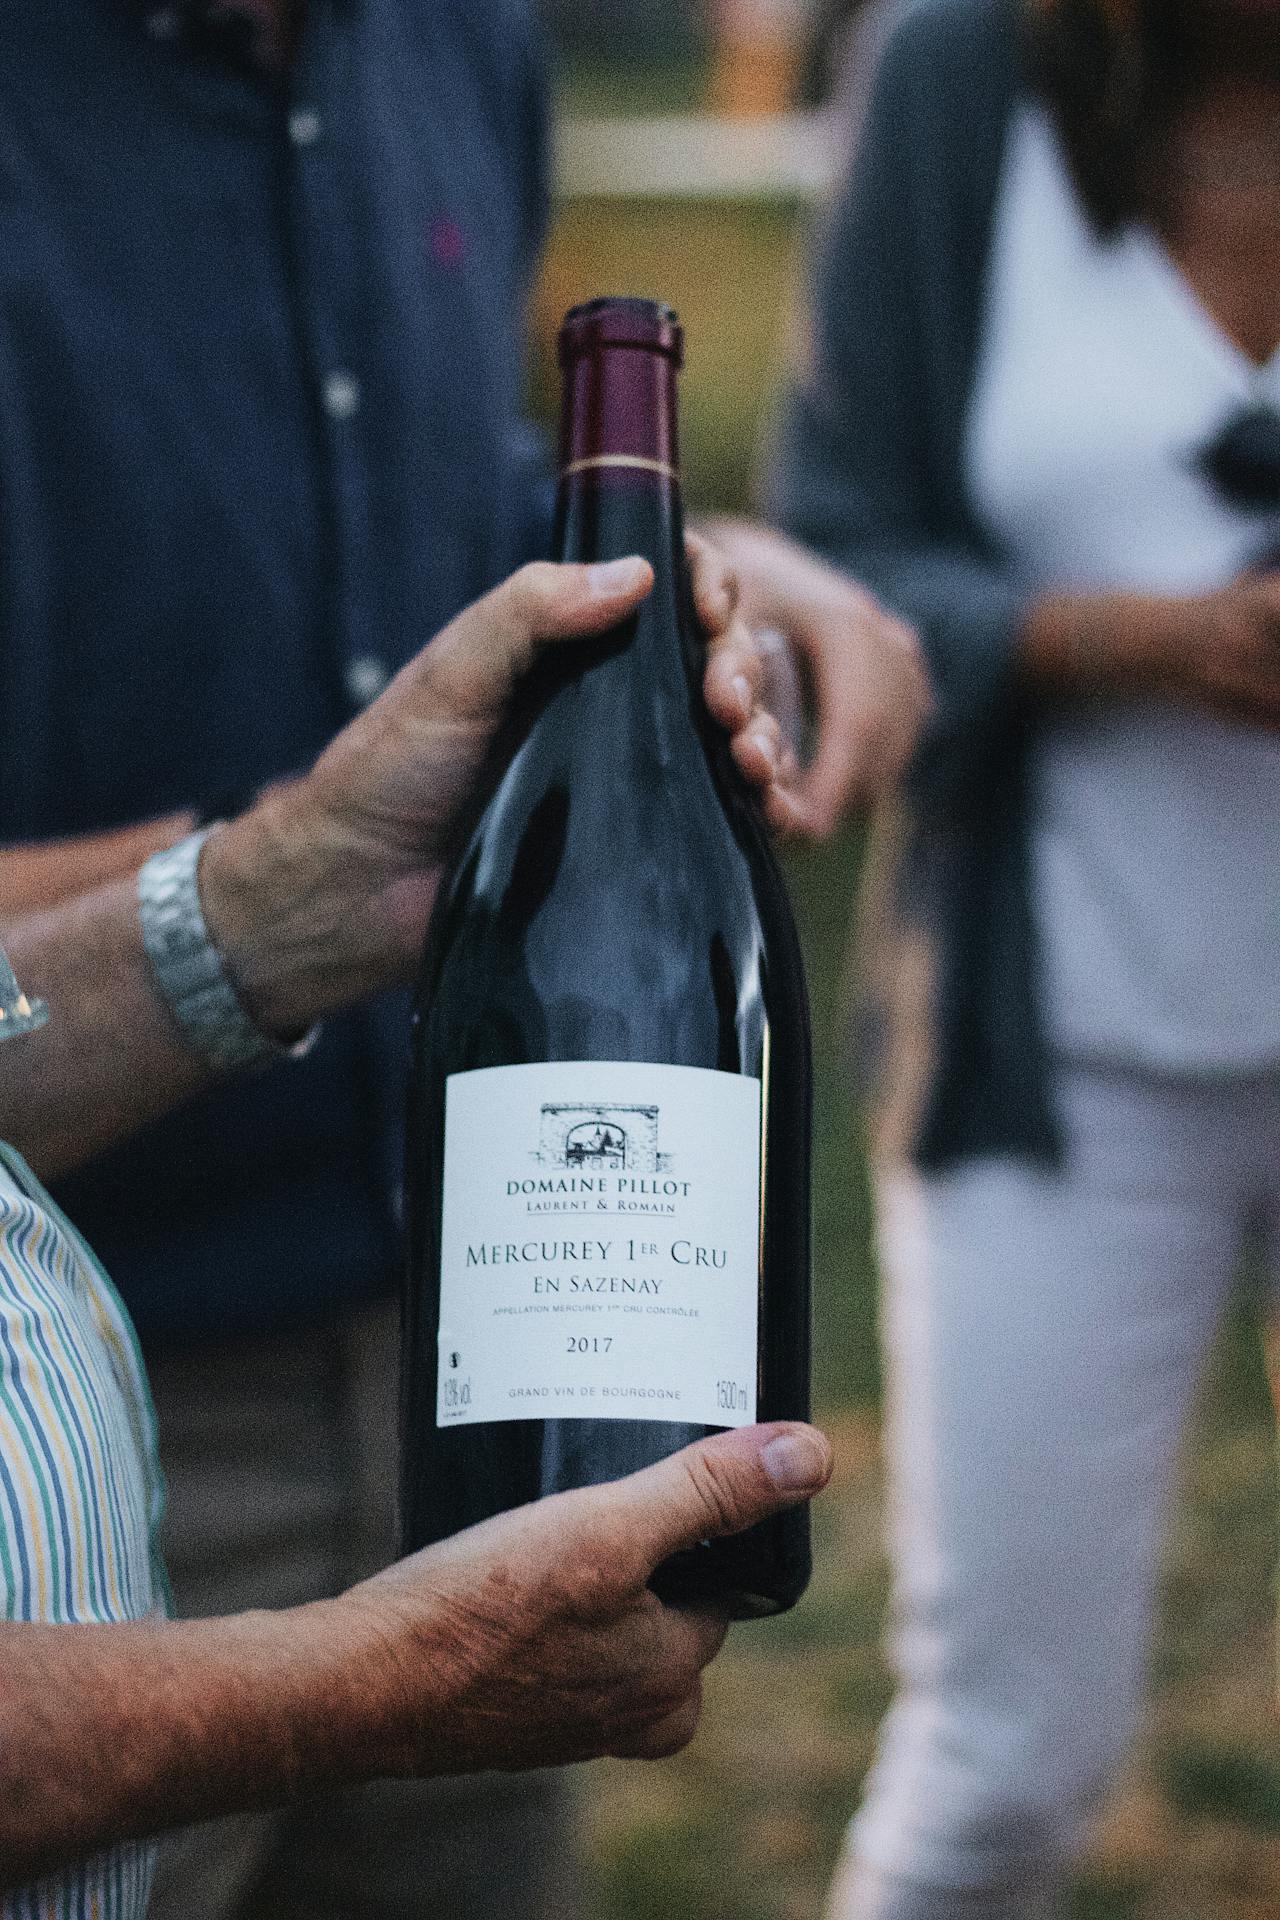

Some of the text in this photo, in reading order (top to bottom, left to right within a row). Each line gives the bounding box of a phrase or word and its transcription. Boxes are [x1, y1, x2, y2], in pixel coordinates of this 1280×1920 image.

[506, 1179, 692, 1197] DOMAINE PILLOT
[527, 1198, 676, 1213] LAURENT & ROMAIN
[465, 1241, 612, 1268] MERCUREY
[670, 1240, 728, 1269] CRU
[533, 1275, 664, 1294] EN SAZENAY
[566, 1337, 614, 1353] 2017
[508, 1386, 682, 1400] GRAND VIN DE BOURGOGNE
